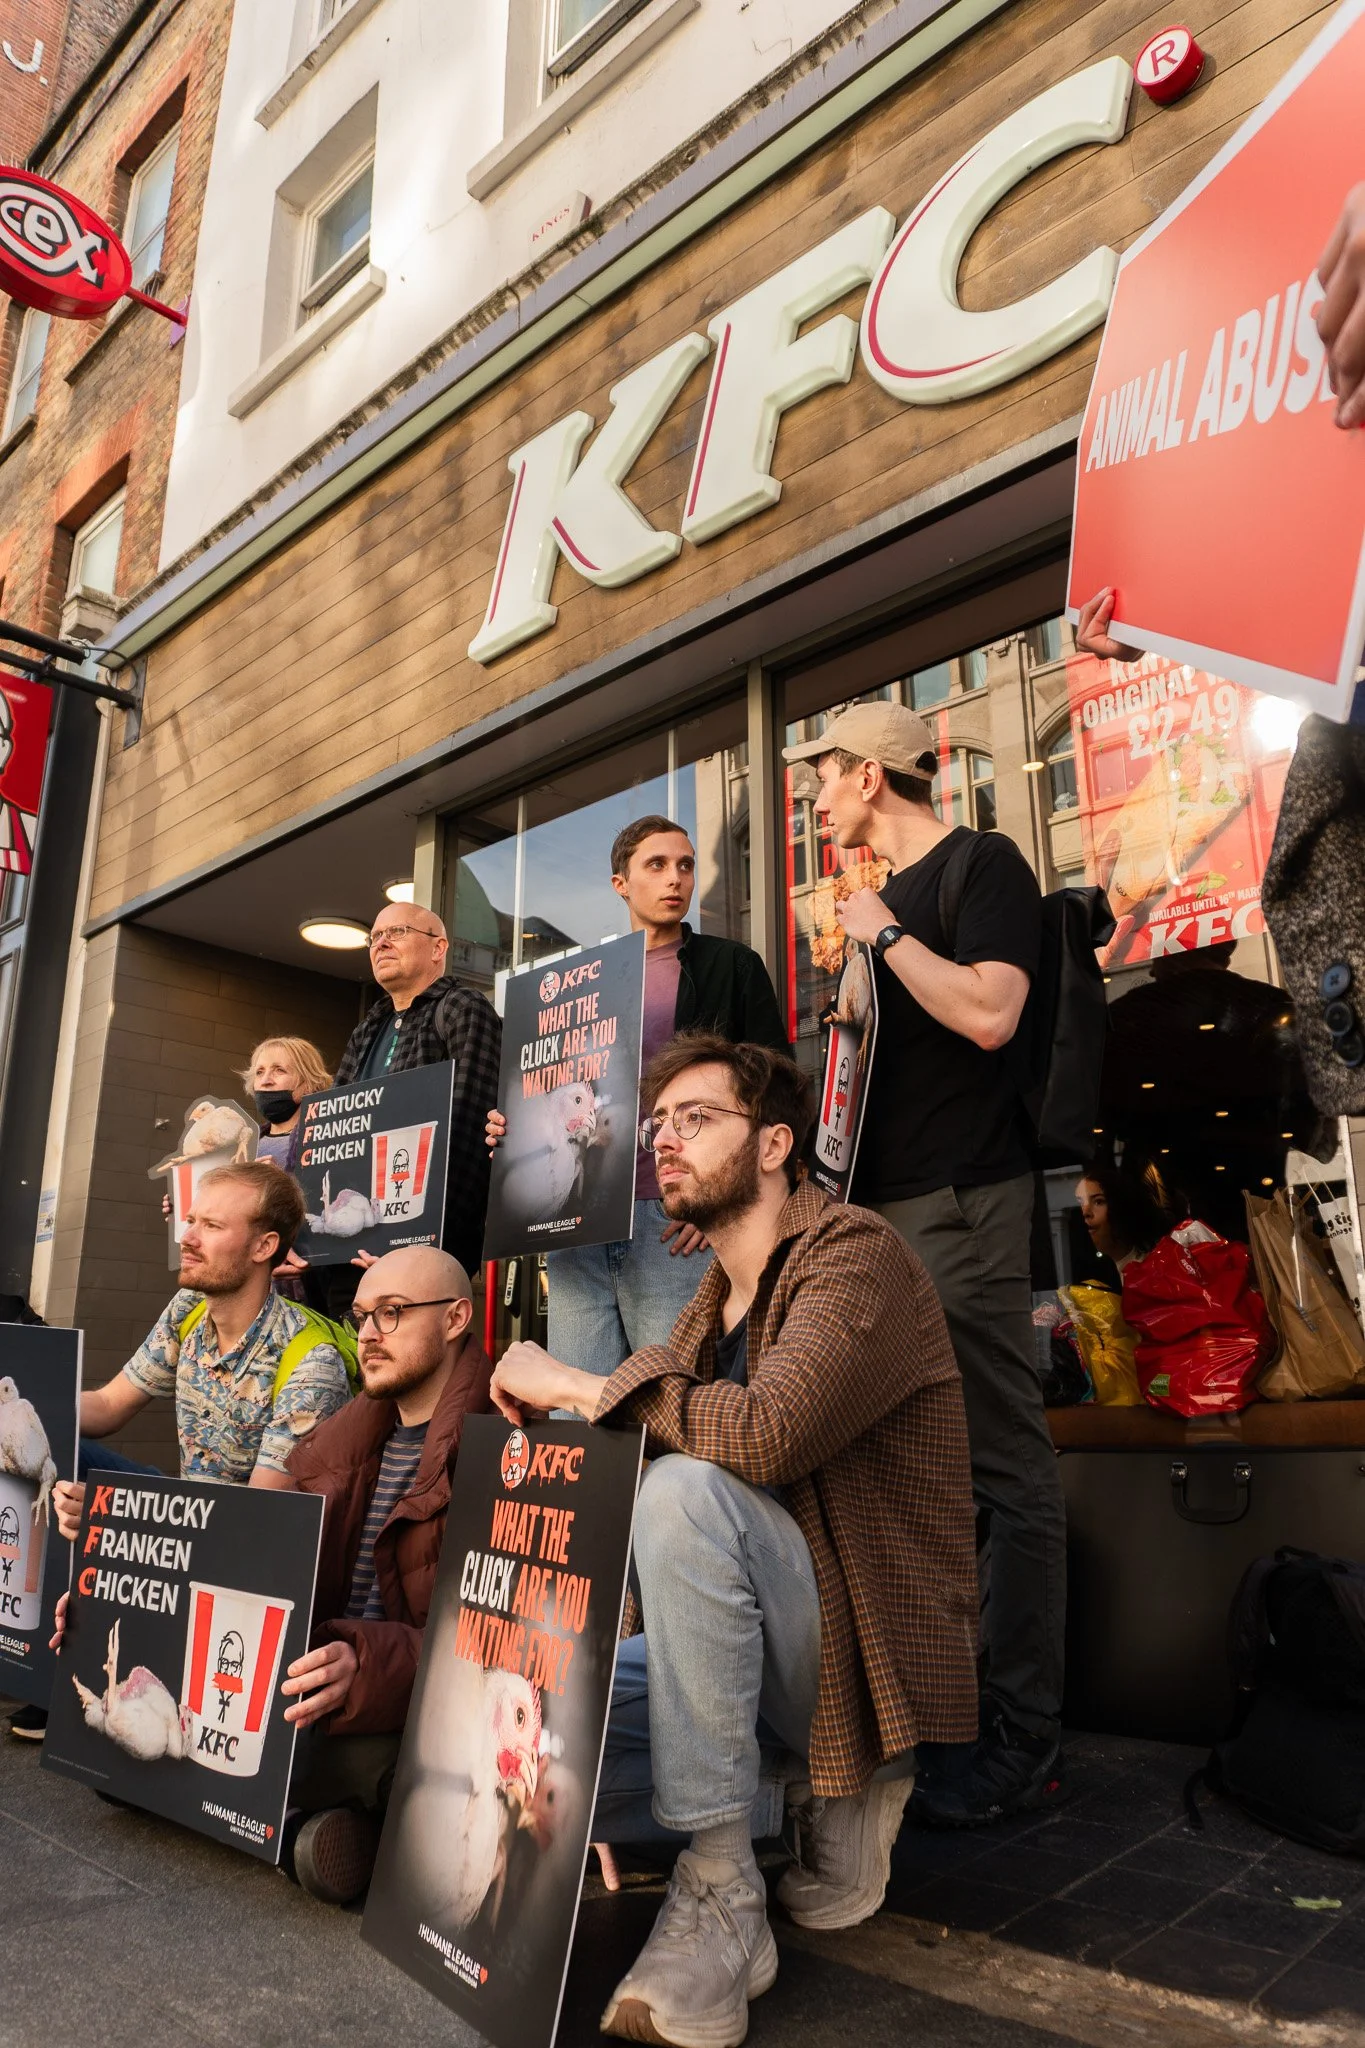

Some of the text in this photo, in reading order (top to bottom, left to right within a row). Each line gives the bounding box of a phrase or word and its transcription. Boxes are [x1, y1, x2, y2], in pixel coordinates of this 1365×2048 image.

[468, 55, 1133, 665] KFC
[1085, 268, 1338, 473] ANIMAL ABUS
[1083, 666, 1199, 728] ORIGINAL
[1127, 685, 1239, 760] £2.49
[1149, 903, 1191, 923] AVAILABLE
[1192, 897, 1217, 913] UNTIL
[1237, 884, 1262, 901] MARC
[1150, 900, 1269, 959] KFC
[560, 960, 602, 993] KFC
[538, 992, 599, 1036] WHAT THE
[520, 1017, 617, 1071] CLUCK ARE YOU
[522, 1050, 610, 1099] WAITING FOR?
[304, 1086, 384, 1123] KENTUCKY
[302, 1114, 372, 1145] FRANKEN
[824, 1134, 843, 1161] KFC
[301, 1139, 366, 1168] CHICKEN
[384, 1201, 410, 1217] KFC
[530, 1221, 554, 1232] HUMANE
[554, 1217, 576, 1228] LEAGUE
[412, 1234, 431, 1243] LEAGUE
[527, 1443, 585, 1487] KFC
[89, 1485, 215, 1529] KENTUCKY
[83, 1526, 193, 1572] FRANKEN
[490, 1499, 575, 1564] WHAT THE
[0, 1590, 21, 1618] FC
[78, 1567, 180, 1616] CHICKEN
[459, 1550, 591, 1635] CLUCK ARE YOU
[5, 1636, 25, 1651] LEAGUE
[454, 1607, 574, 1697] WAITING FOR?
[197, 1726, 239, 1763] KFC
[204, 1801, 237, 1824] HUMANE
[237, 1813, 266, 1837] LEAGUE
[420, 1924, 480, 1980] HUMANE LEAGUE
